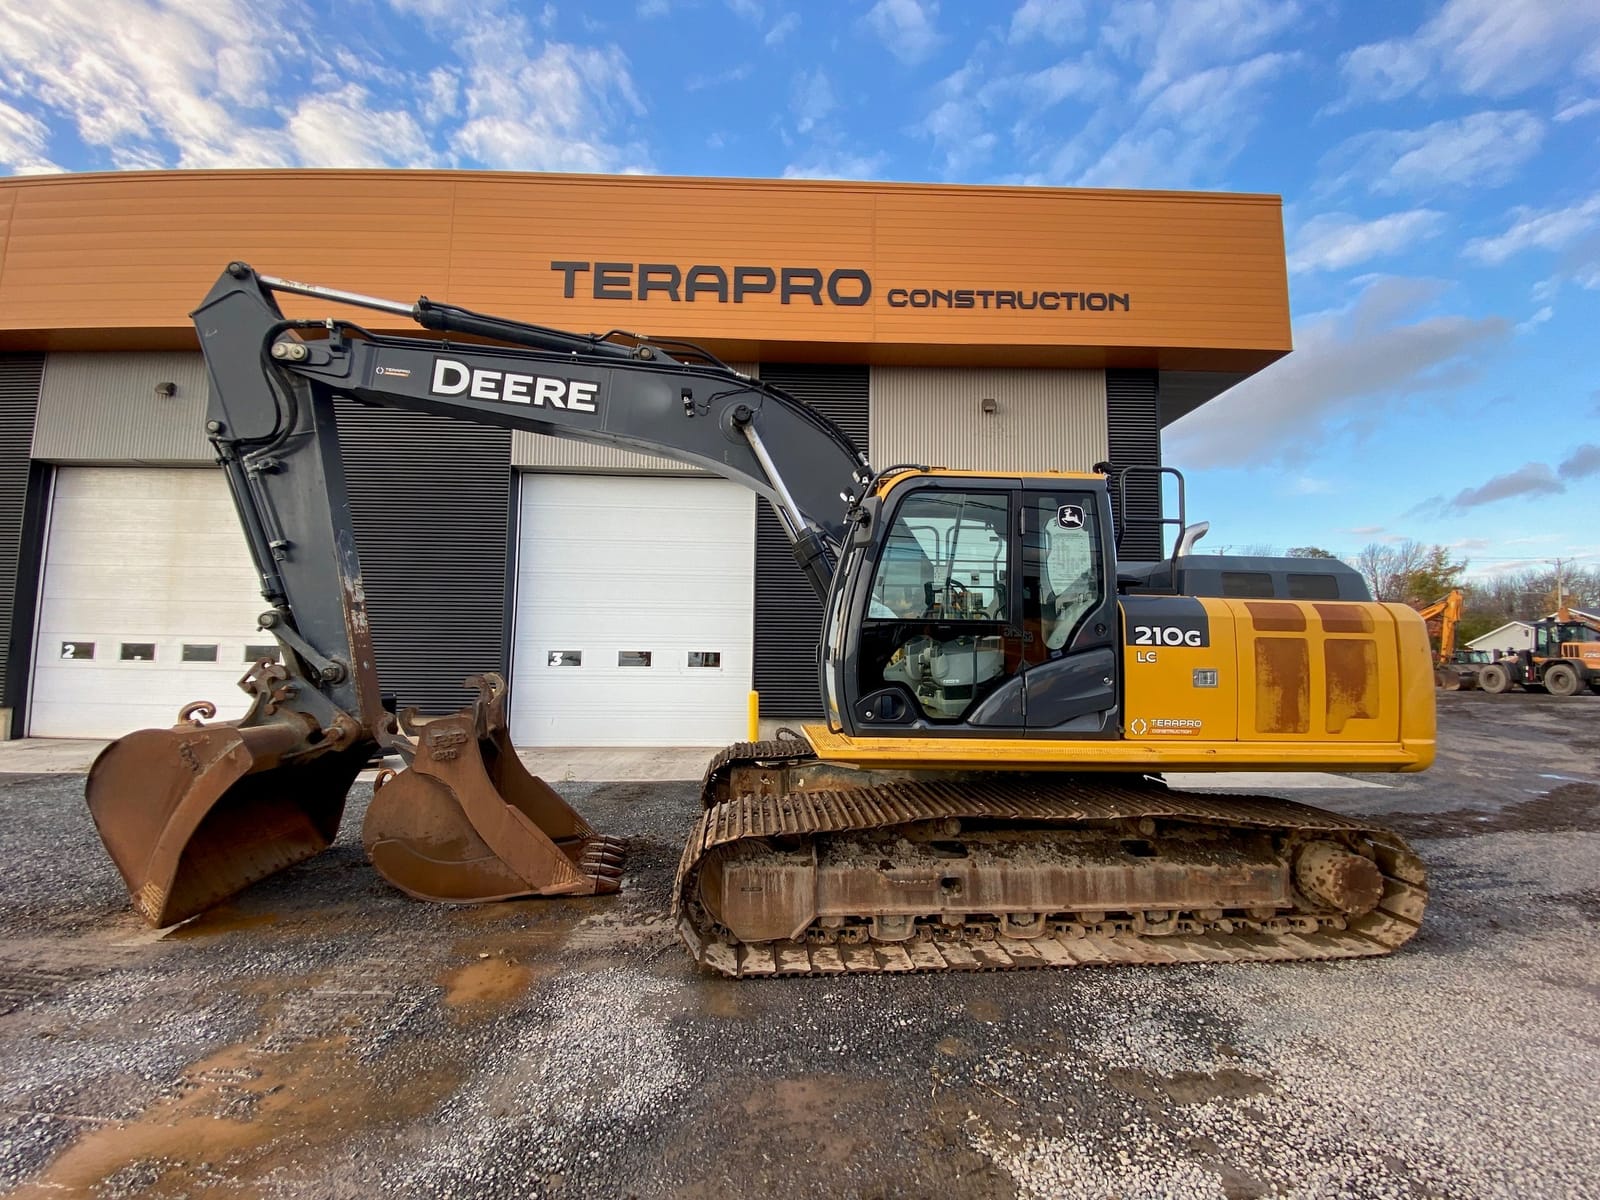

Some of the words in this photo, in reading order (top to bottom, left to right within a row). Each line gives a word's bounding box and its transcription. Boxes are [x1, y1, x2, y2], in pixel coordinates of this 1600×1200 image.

[550, 260, 872, 306] TERAPRO
[887, 288, 1130, 312] CONSTRUCTION
[432, 358, 598, 412] DEERE
[1134, 626, 1201, 646] 210G
[62, 644, 75, 659] 2
[550, 652, 563, 666] 3
[1136, 651, 1157, 663] LC
[1150, 719, 1202, 727] TERAPRO
